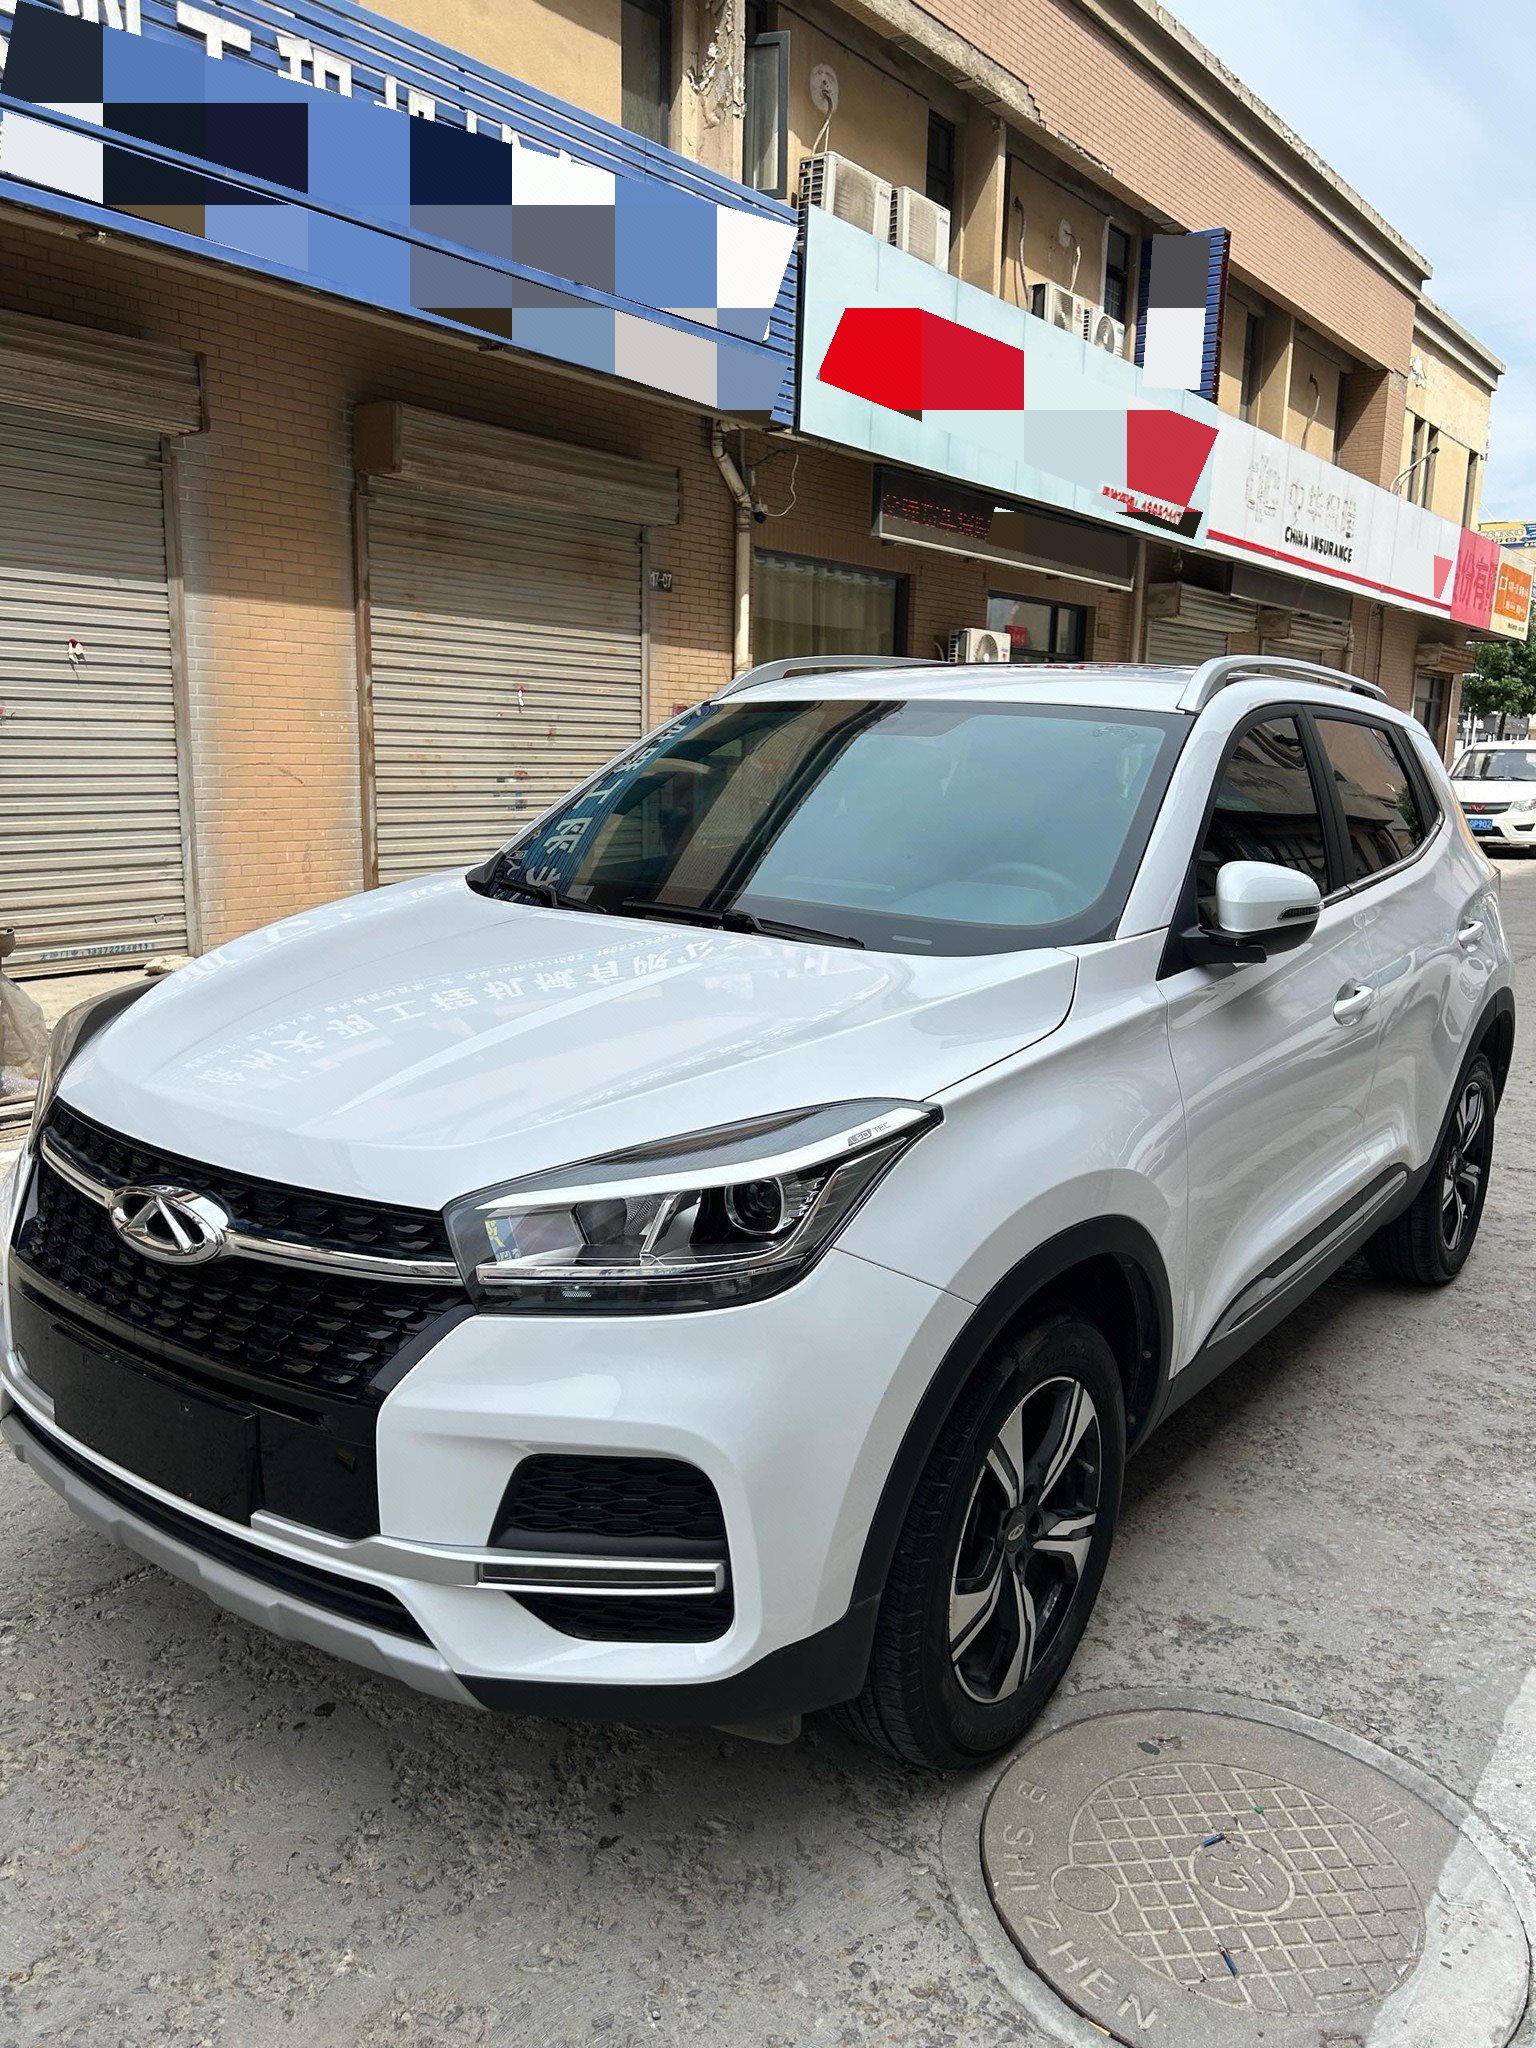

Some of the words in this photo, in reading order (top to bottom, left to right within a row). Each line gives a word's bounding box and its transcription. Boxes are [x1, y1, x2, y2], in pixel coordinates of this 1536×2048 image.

[1284, 526, 1309, 549] CHINA
[1310, 534, 1353, 563] INSURANCE
[849, 1128, 872, 1145] LED
[873, 1121, 892, 1133] TEC
[1002, 1824, 1041, 1892] SHI
[1021, 1907, 1161, 2031] ZHEN
